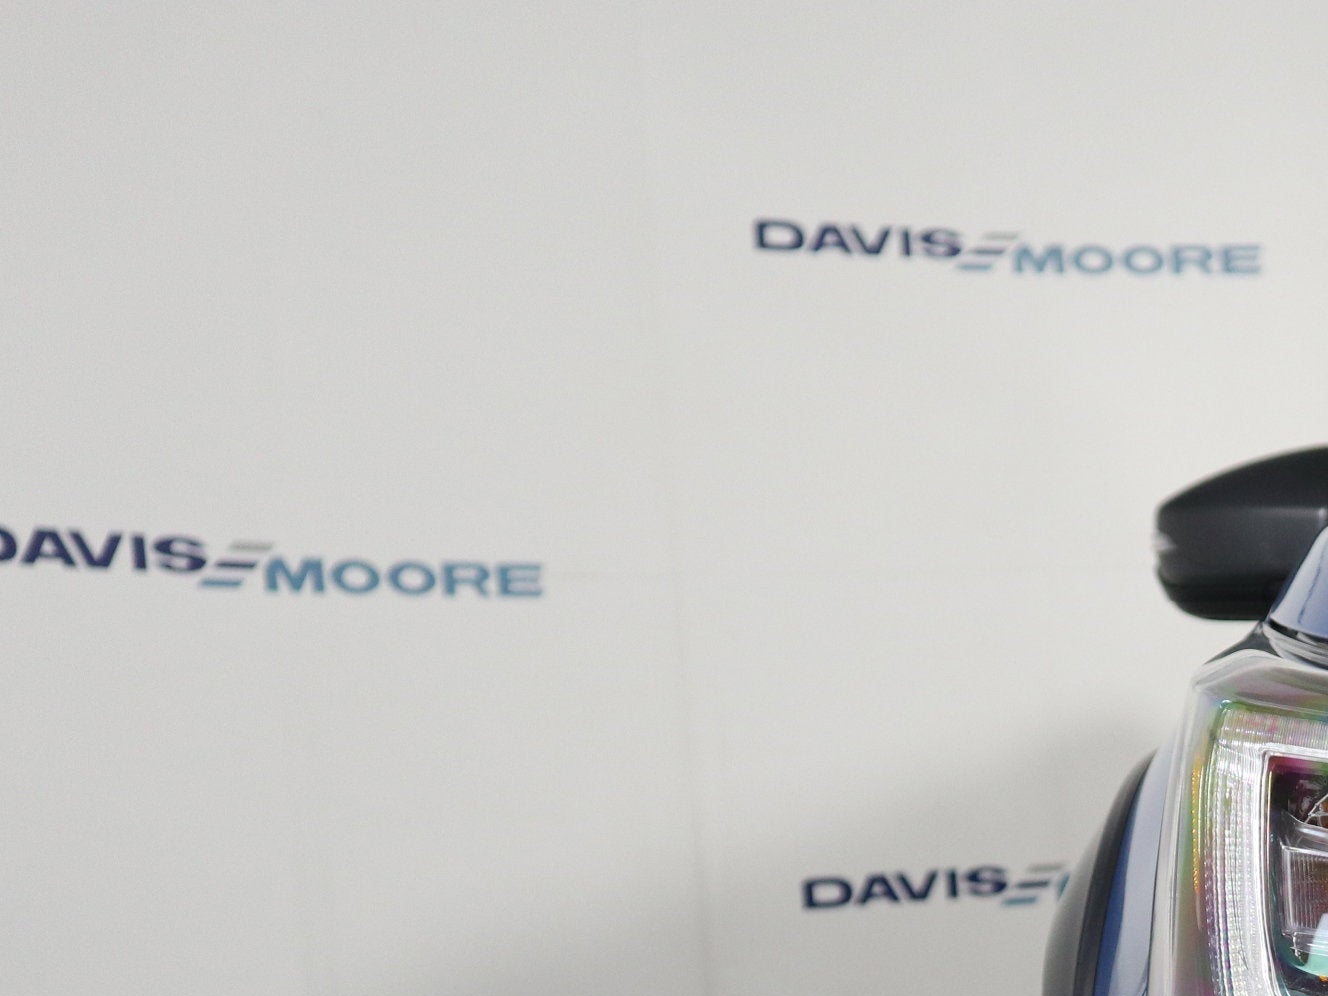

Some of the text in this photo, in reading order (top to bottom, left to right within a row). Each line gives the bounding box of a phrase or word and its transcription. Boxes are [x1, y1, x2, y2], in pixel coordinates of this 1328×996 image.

[752, 217, 1262, 275] DAVIS MOORE
[263, 555, 543, 599] MOORE
[801, 865, 1010, 911] DAVIS
